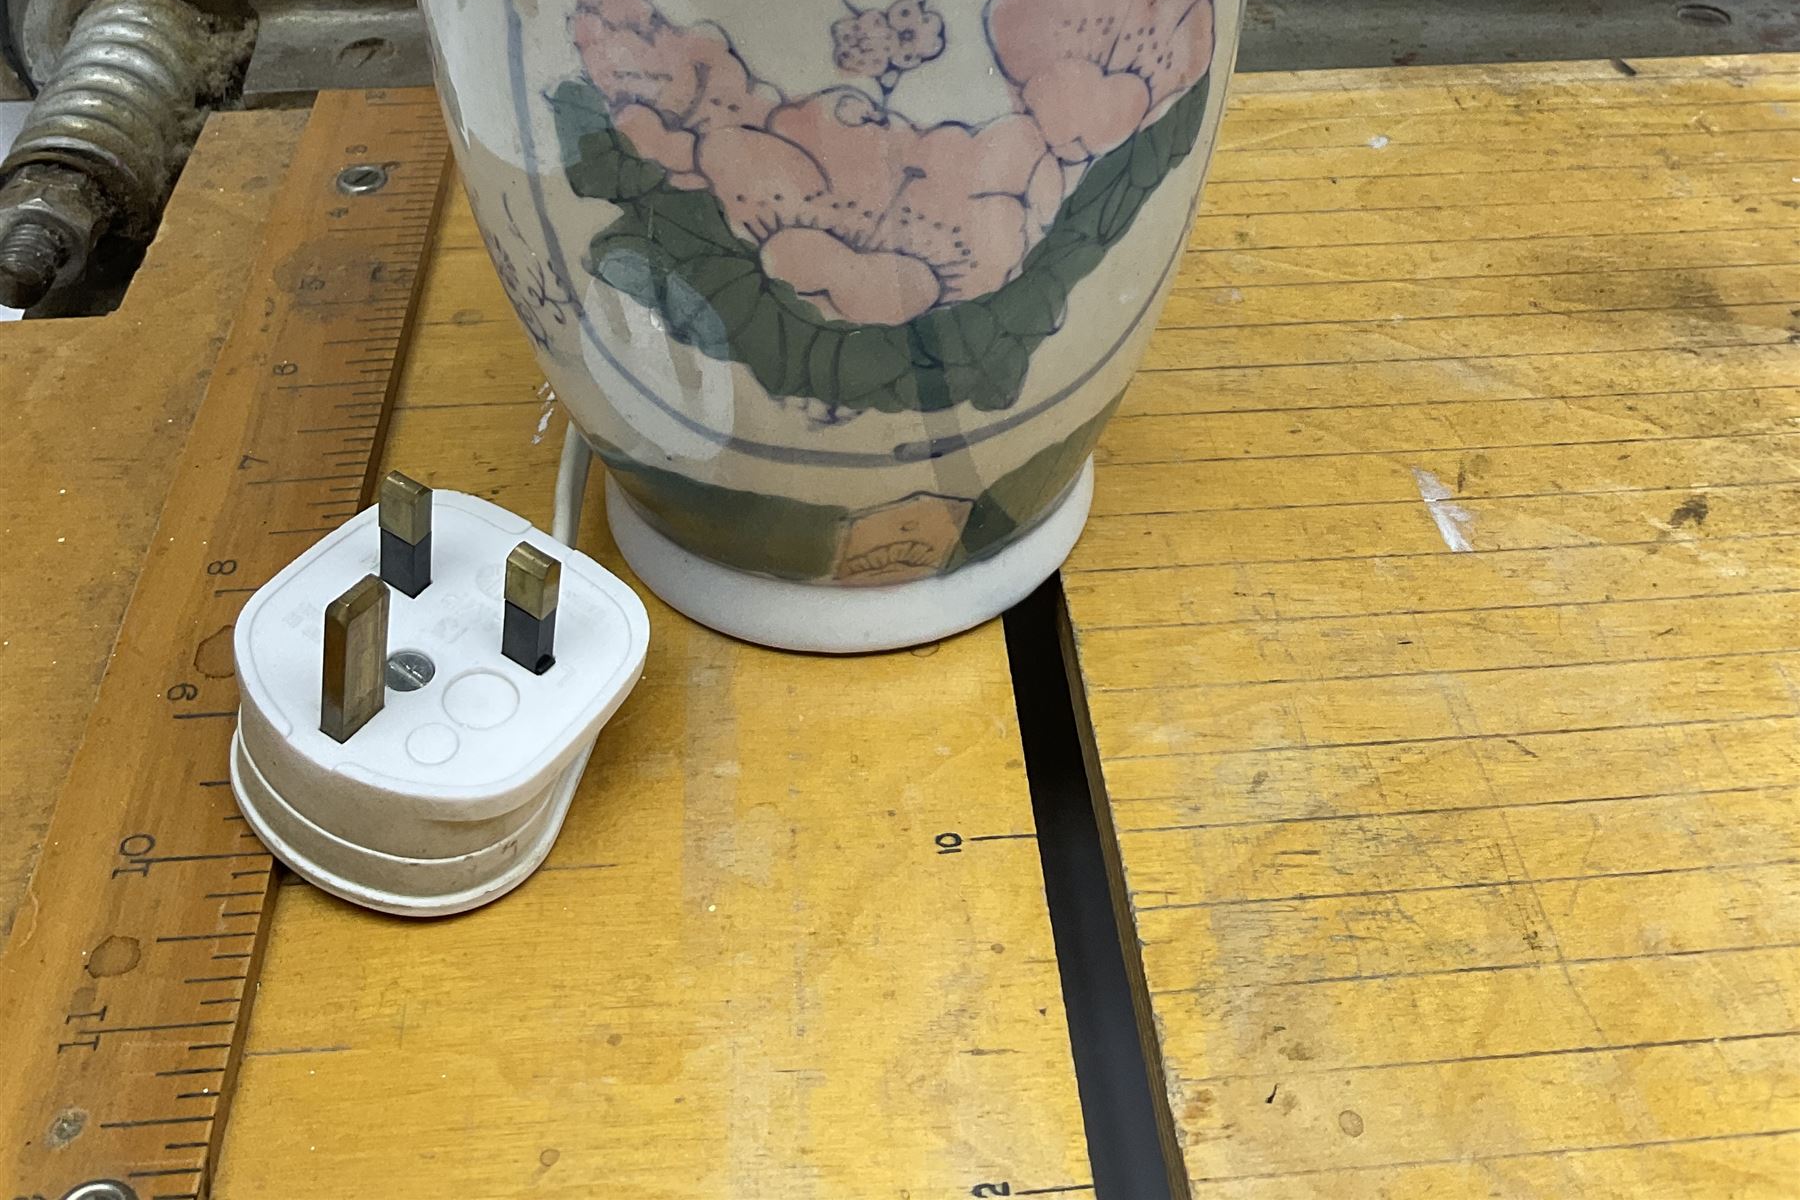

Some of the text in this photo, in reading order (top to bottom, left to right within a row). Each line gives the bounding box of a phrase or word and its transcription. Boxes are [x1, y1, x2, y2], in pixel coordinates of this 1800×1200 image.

[237, 455, 268, 470] 7
[207, 559, 237, 576] 8
[166, 682, 198, 701] 9
[935, 832, 962, 855] 10
[111, 833, 156, 879] 10
[57, 1005, 108, 1055] 11
